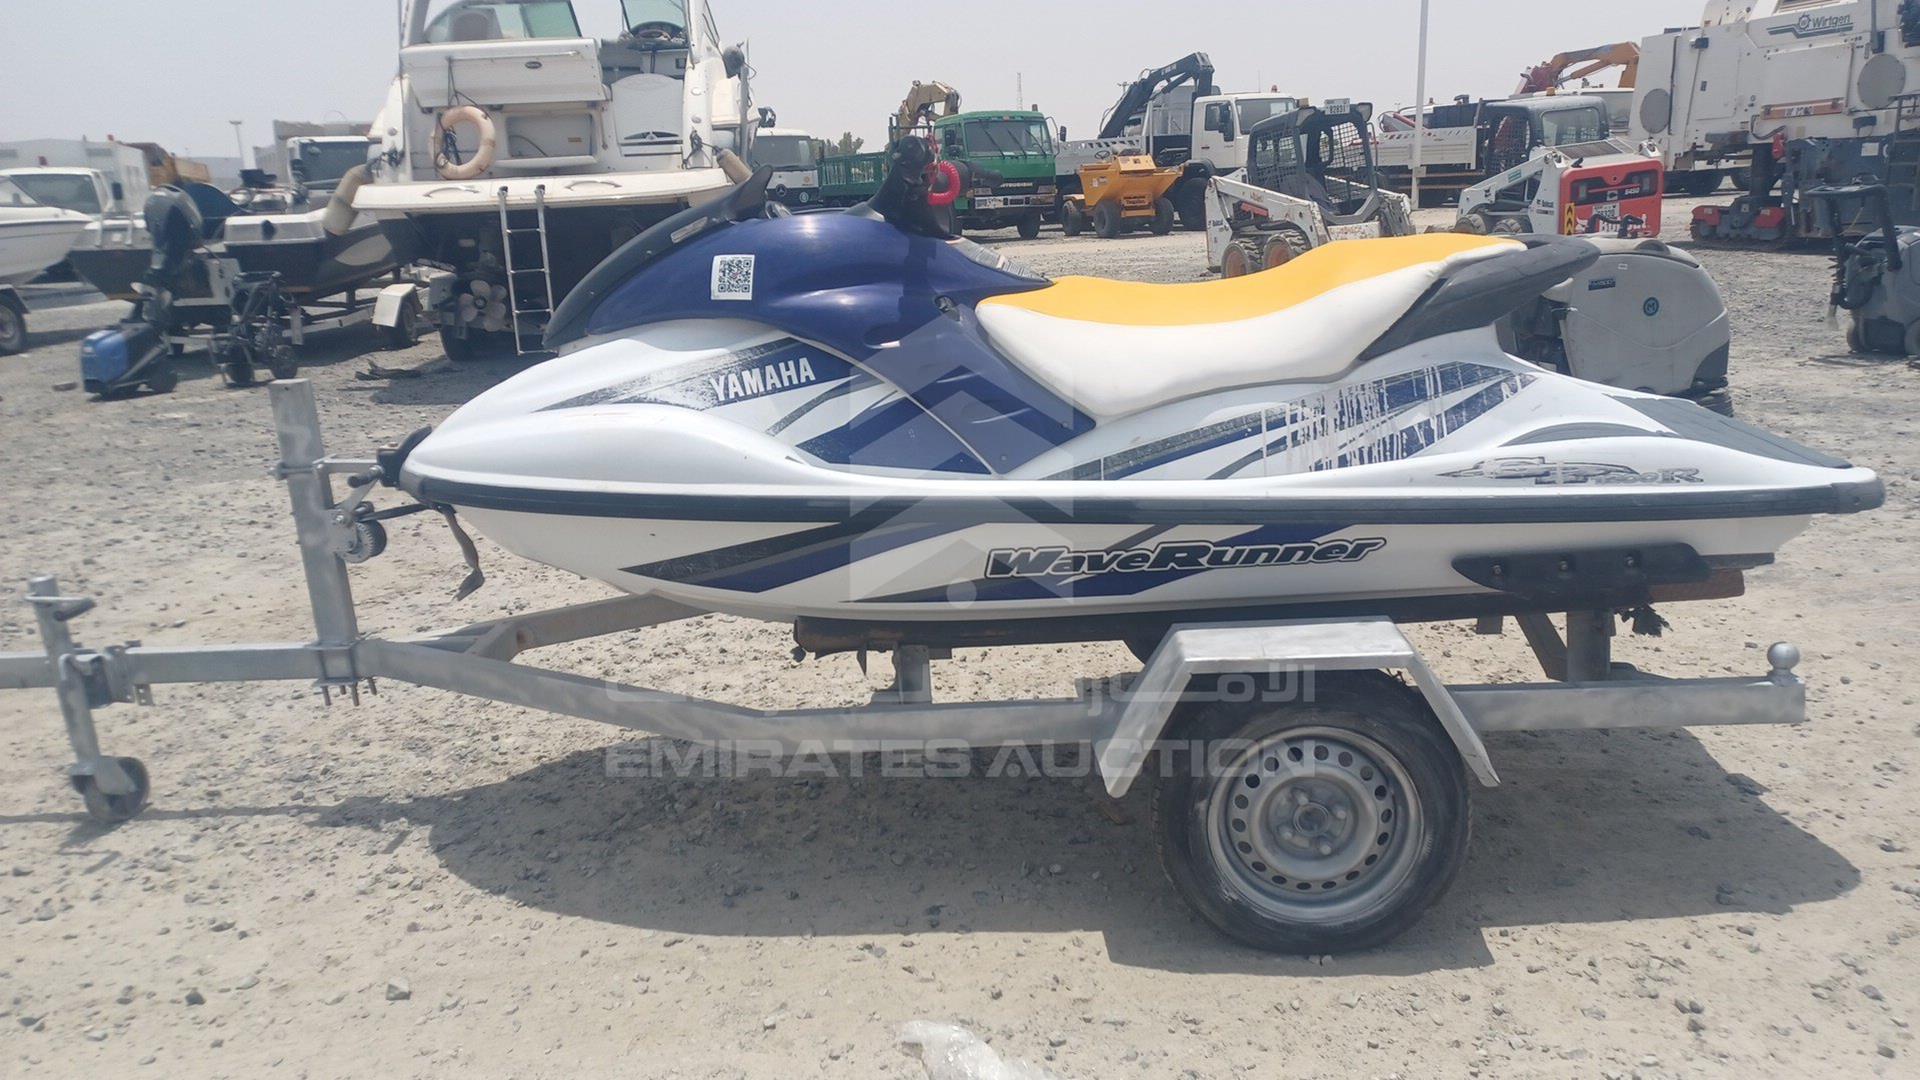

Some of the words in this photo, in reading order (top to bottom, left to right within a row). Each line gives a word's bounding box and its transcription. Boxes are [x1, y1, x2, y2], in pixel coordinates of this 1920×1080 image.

[1812, 14, 1851, 29] Wirtgen
[709, 357, 816, 401] YAMAHA
[984, 537, 1387, 578] WaveRunner
